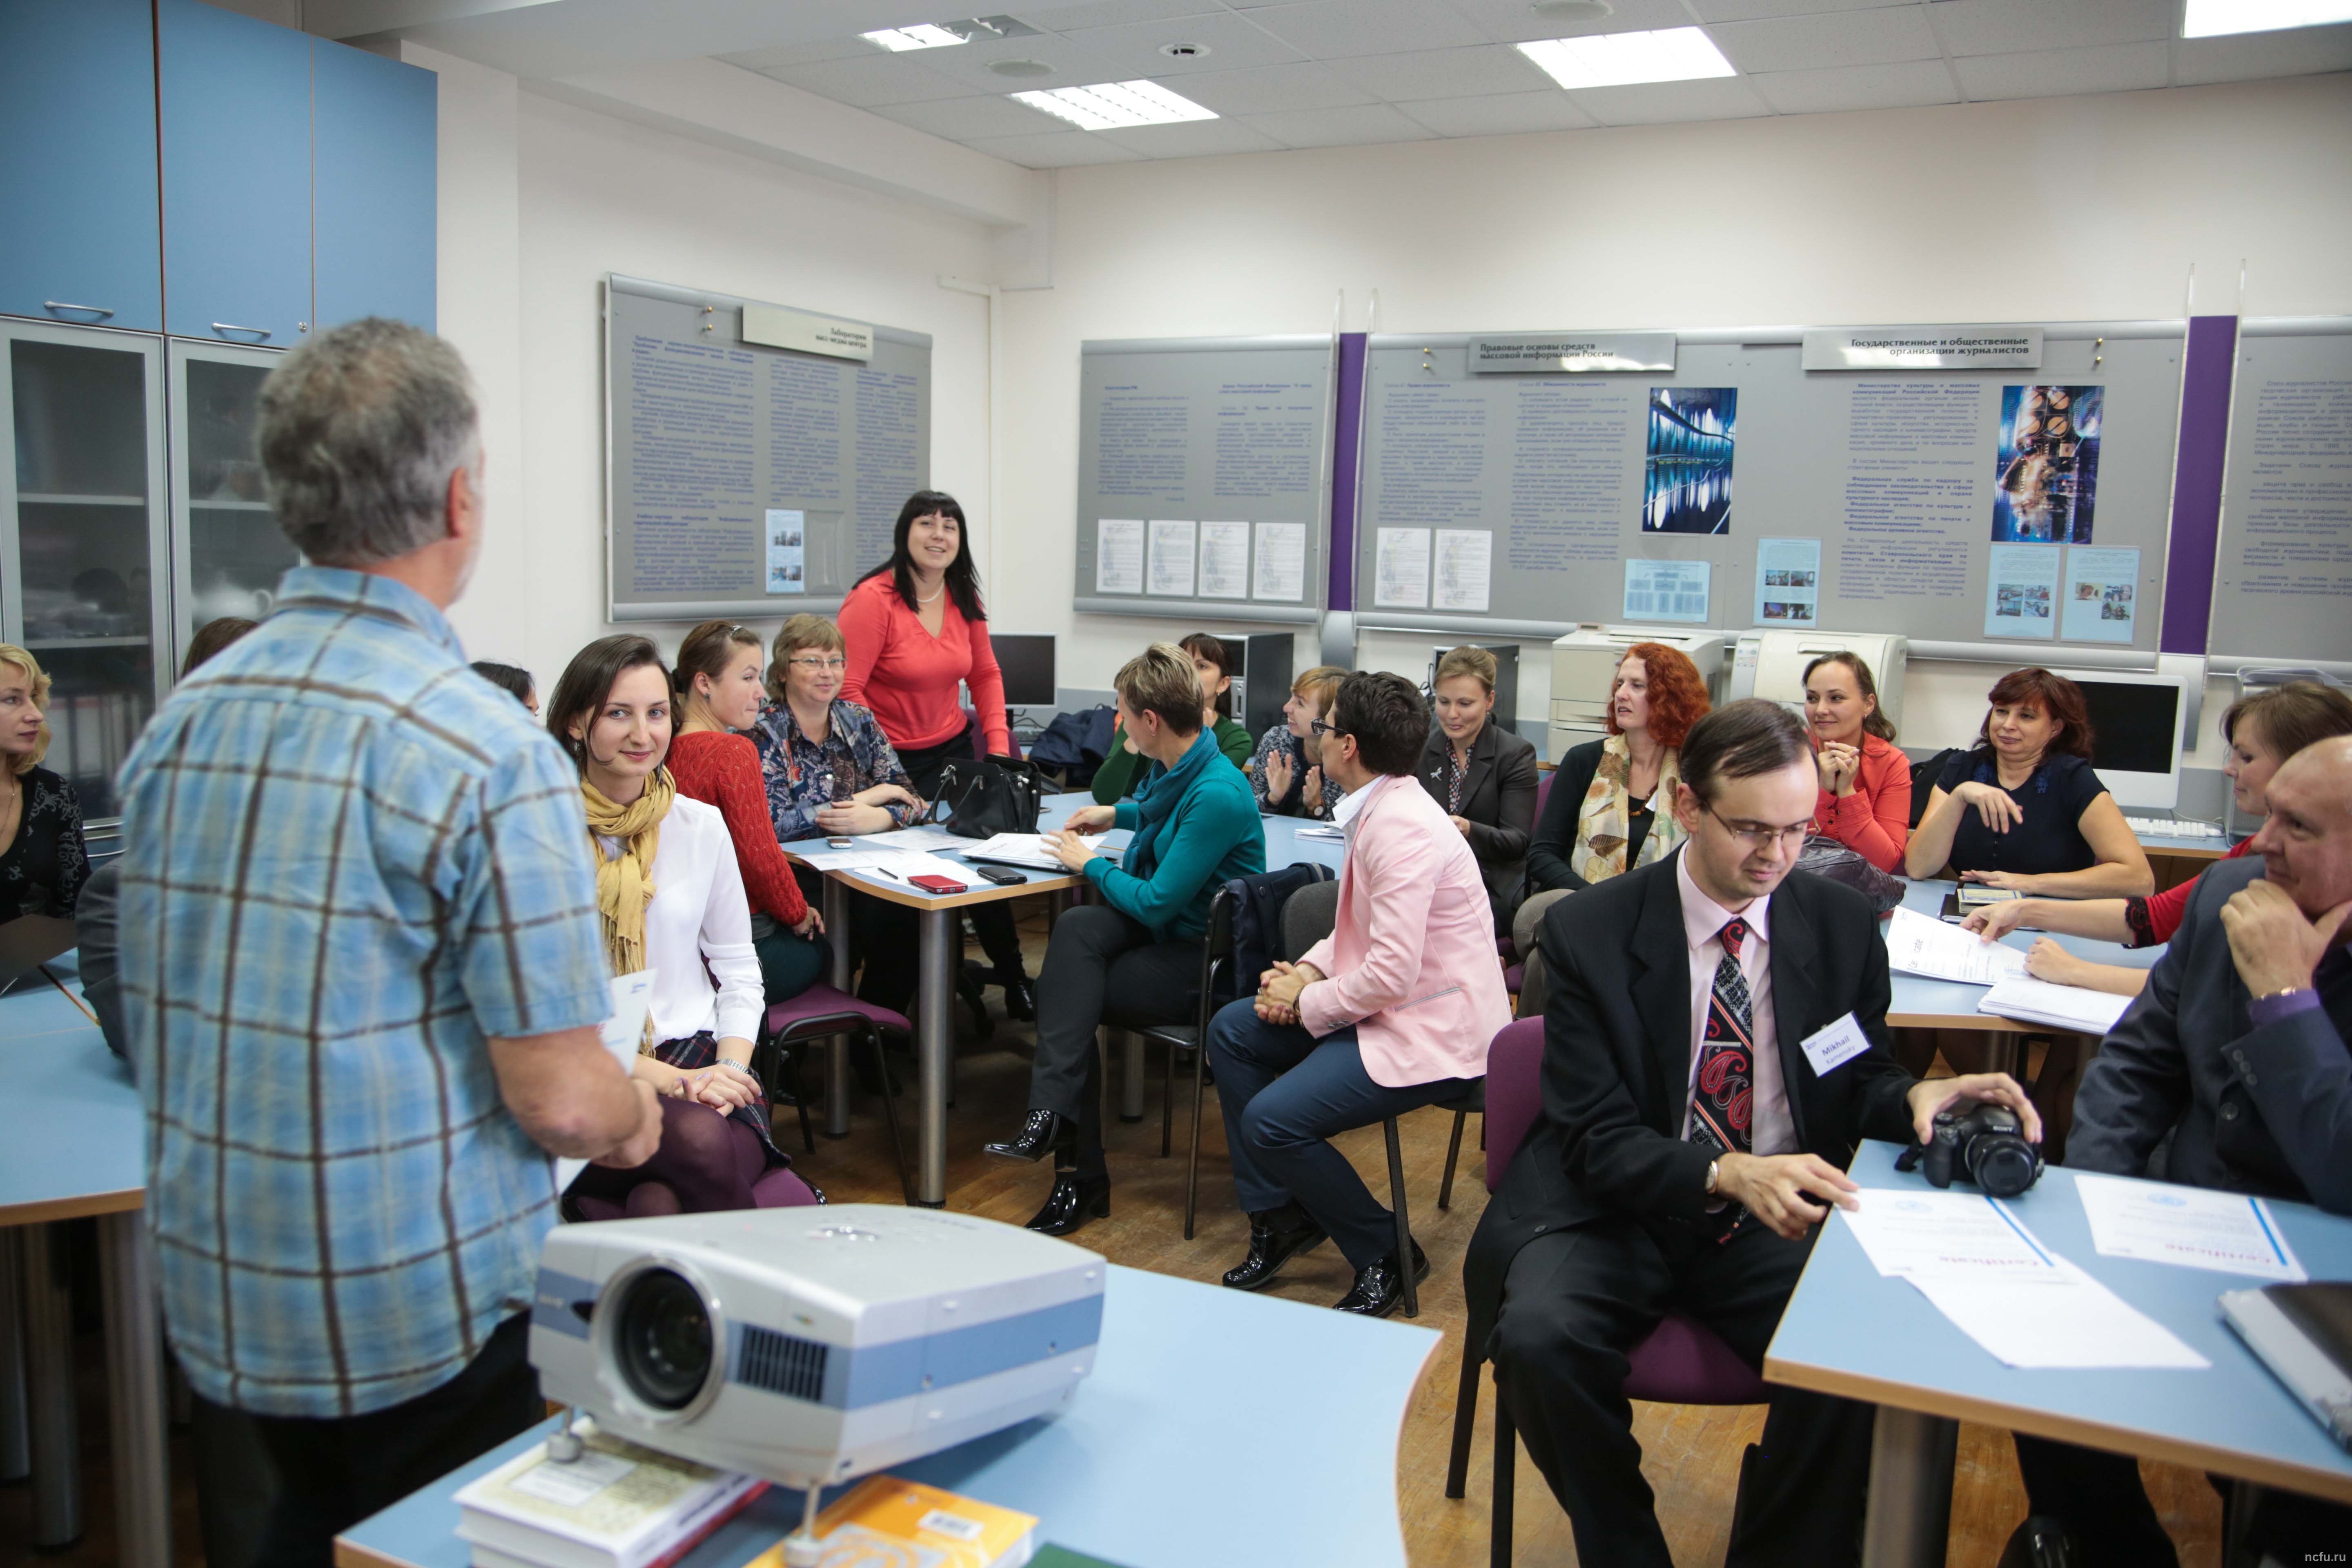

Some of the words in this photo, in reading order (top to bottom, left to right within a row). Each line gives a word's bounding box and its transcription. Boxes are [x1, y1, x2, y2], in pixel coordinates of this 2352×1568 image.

[1480, 344, 1524, 352] Правовые
[1561, 343, 1595, 352] средств
[1851, 339, 1937, 348] Государственные
[1949, 338, 2028, 347] общественные
[1480, 351, 1520, 359] массовой
[1523, 350, 1580, 360] информации
[1889, 347, 1954, 356] организации
[1958, 346, 2029, 356] журналистов
[1822, 1035, 1850, 1056] Mikhail
[1826, 1045, 1855, 1065] Kamensky
[2165, 1243, 2270, 1264] Certificate
[1938, 1256, 2037, 1267] Certificate
